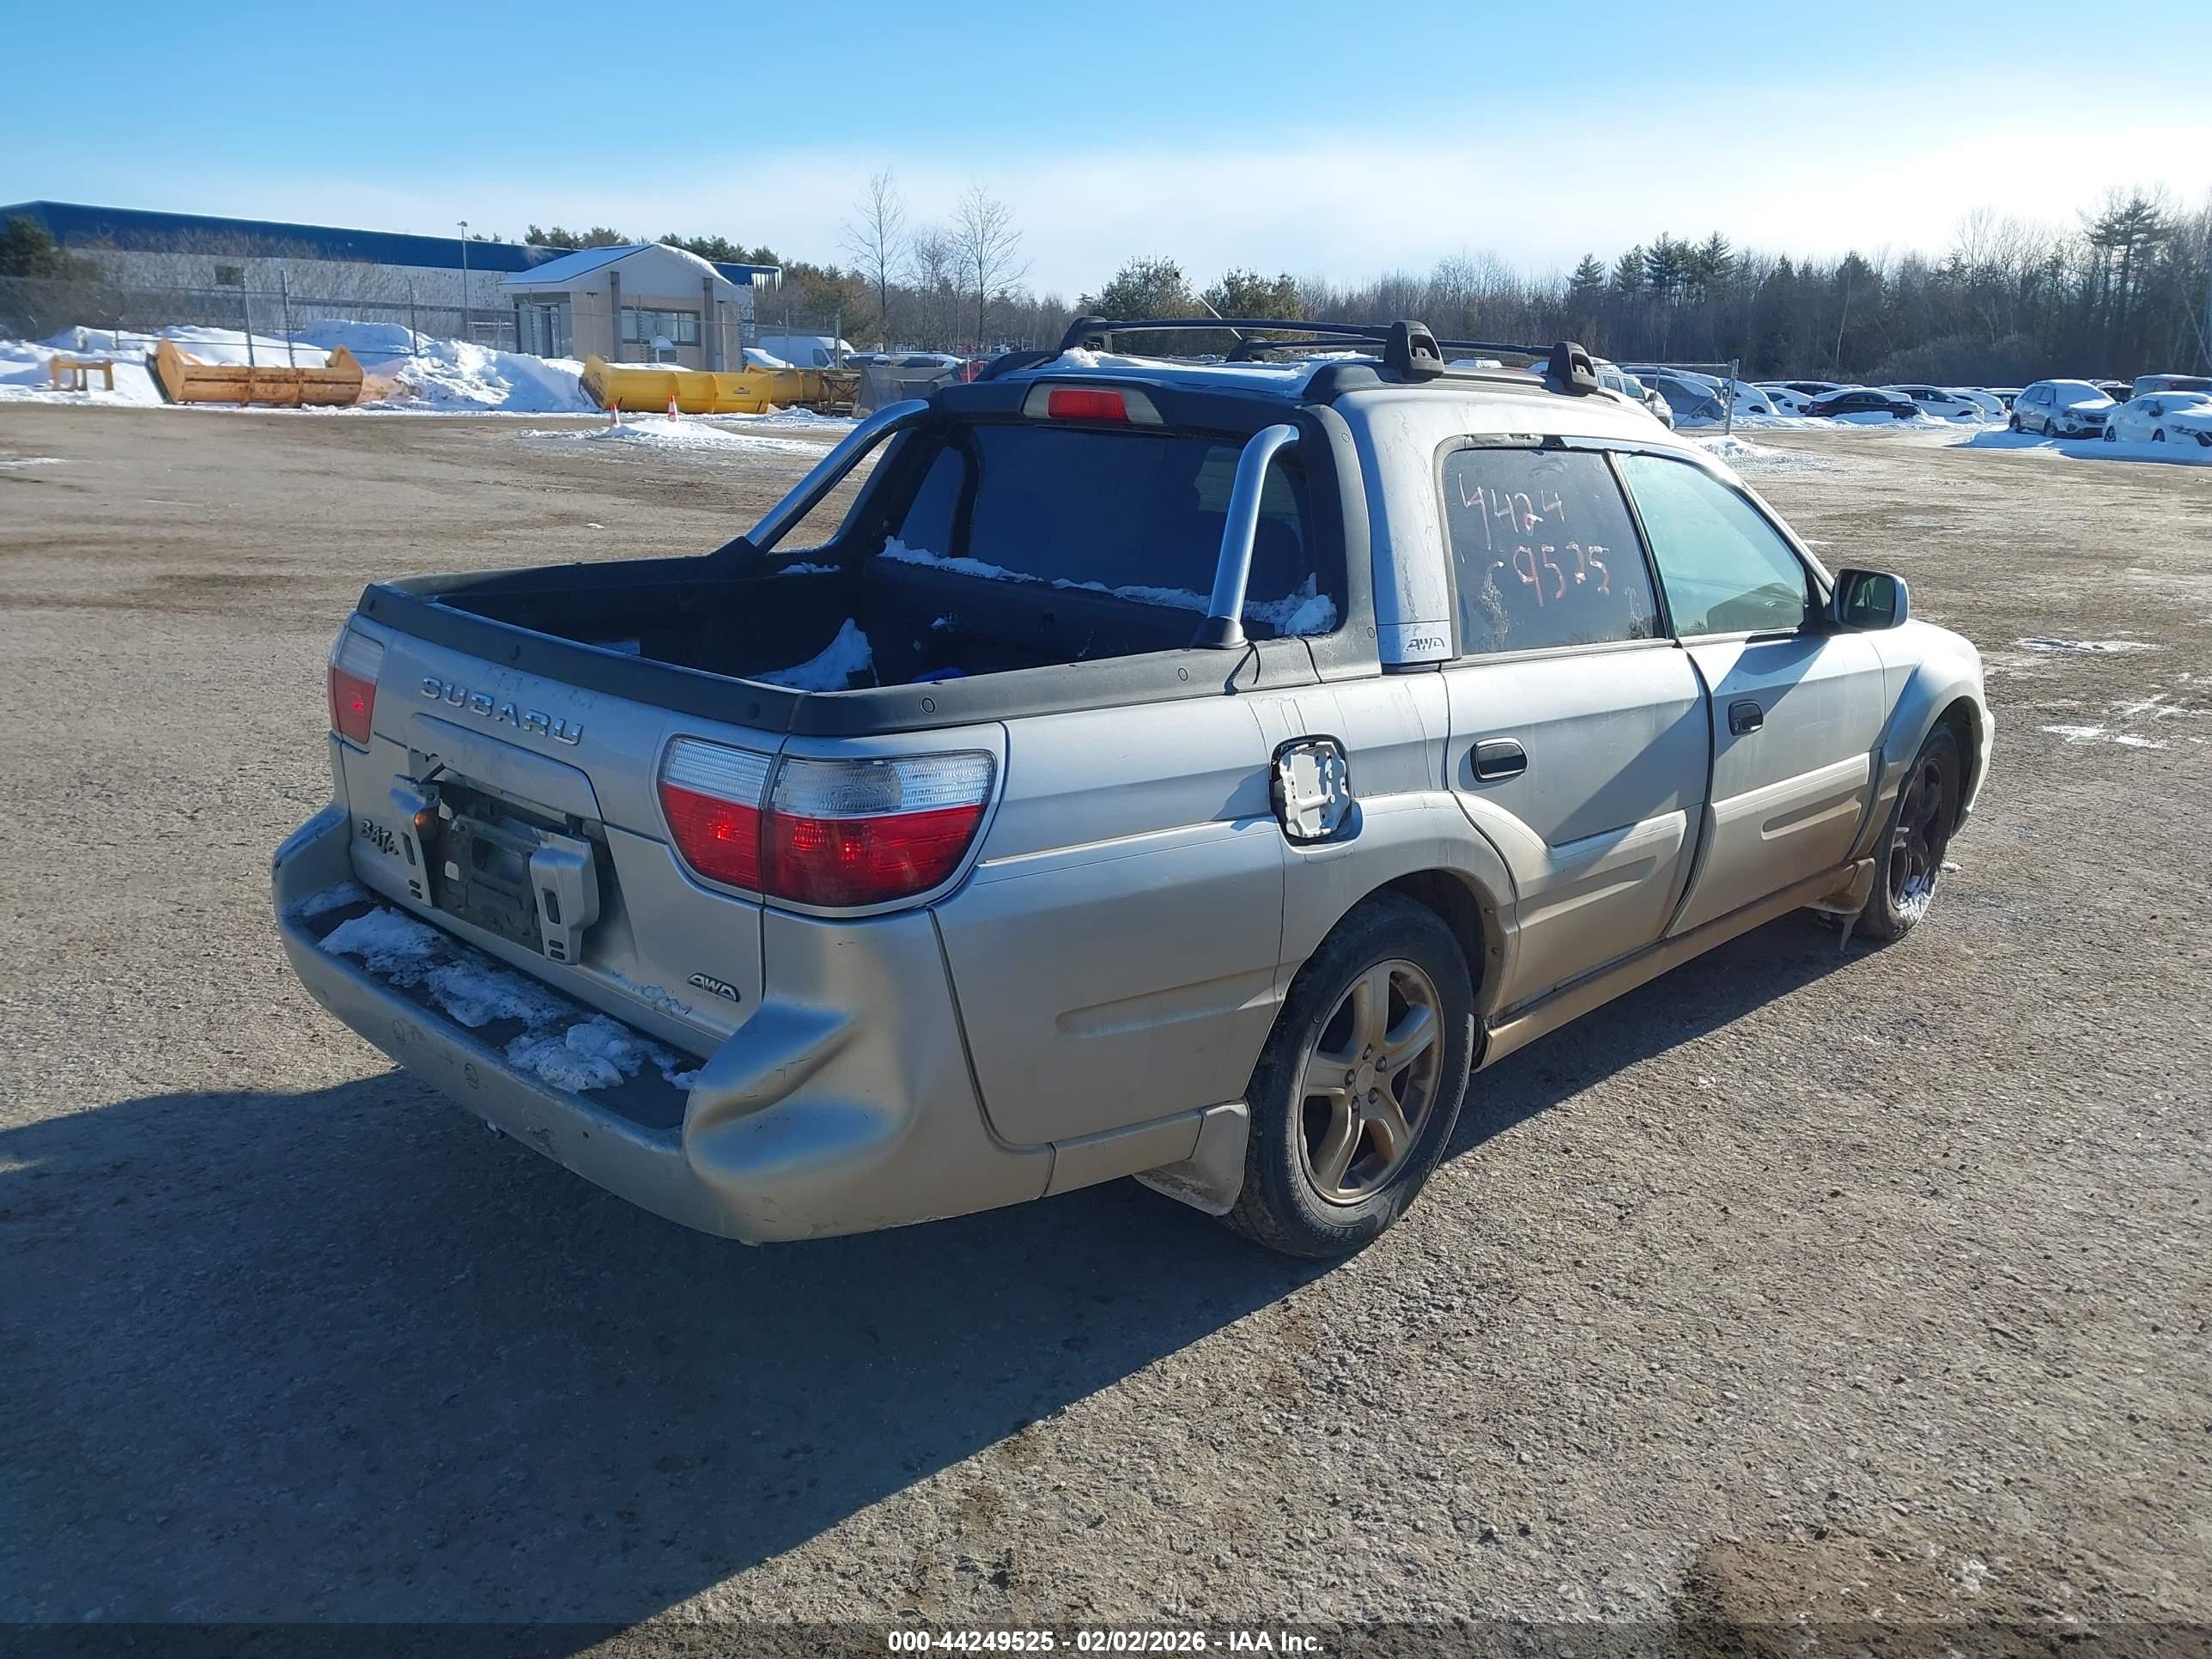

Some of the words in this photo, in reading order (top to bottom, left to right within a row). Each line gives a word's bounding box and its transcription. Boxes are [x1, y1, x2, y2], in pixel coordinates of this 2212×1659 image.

[1458, 473, 1566, 550] 4424
[420, 676, 585, 746] SUBARU
[687, 972, 739, 1003] AWD
